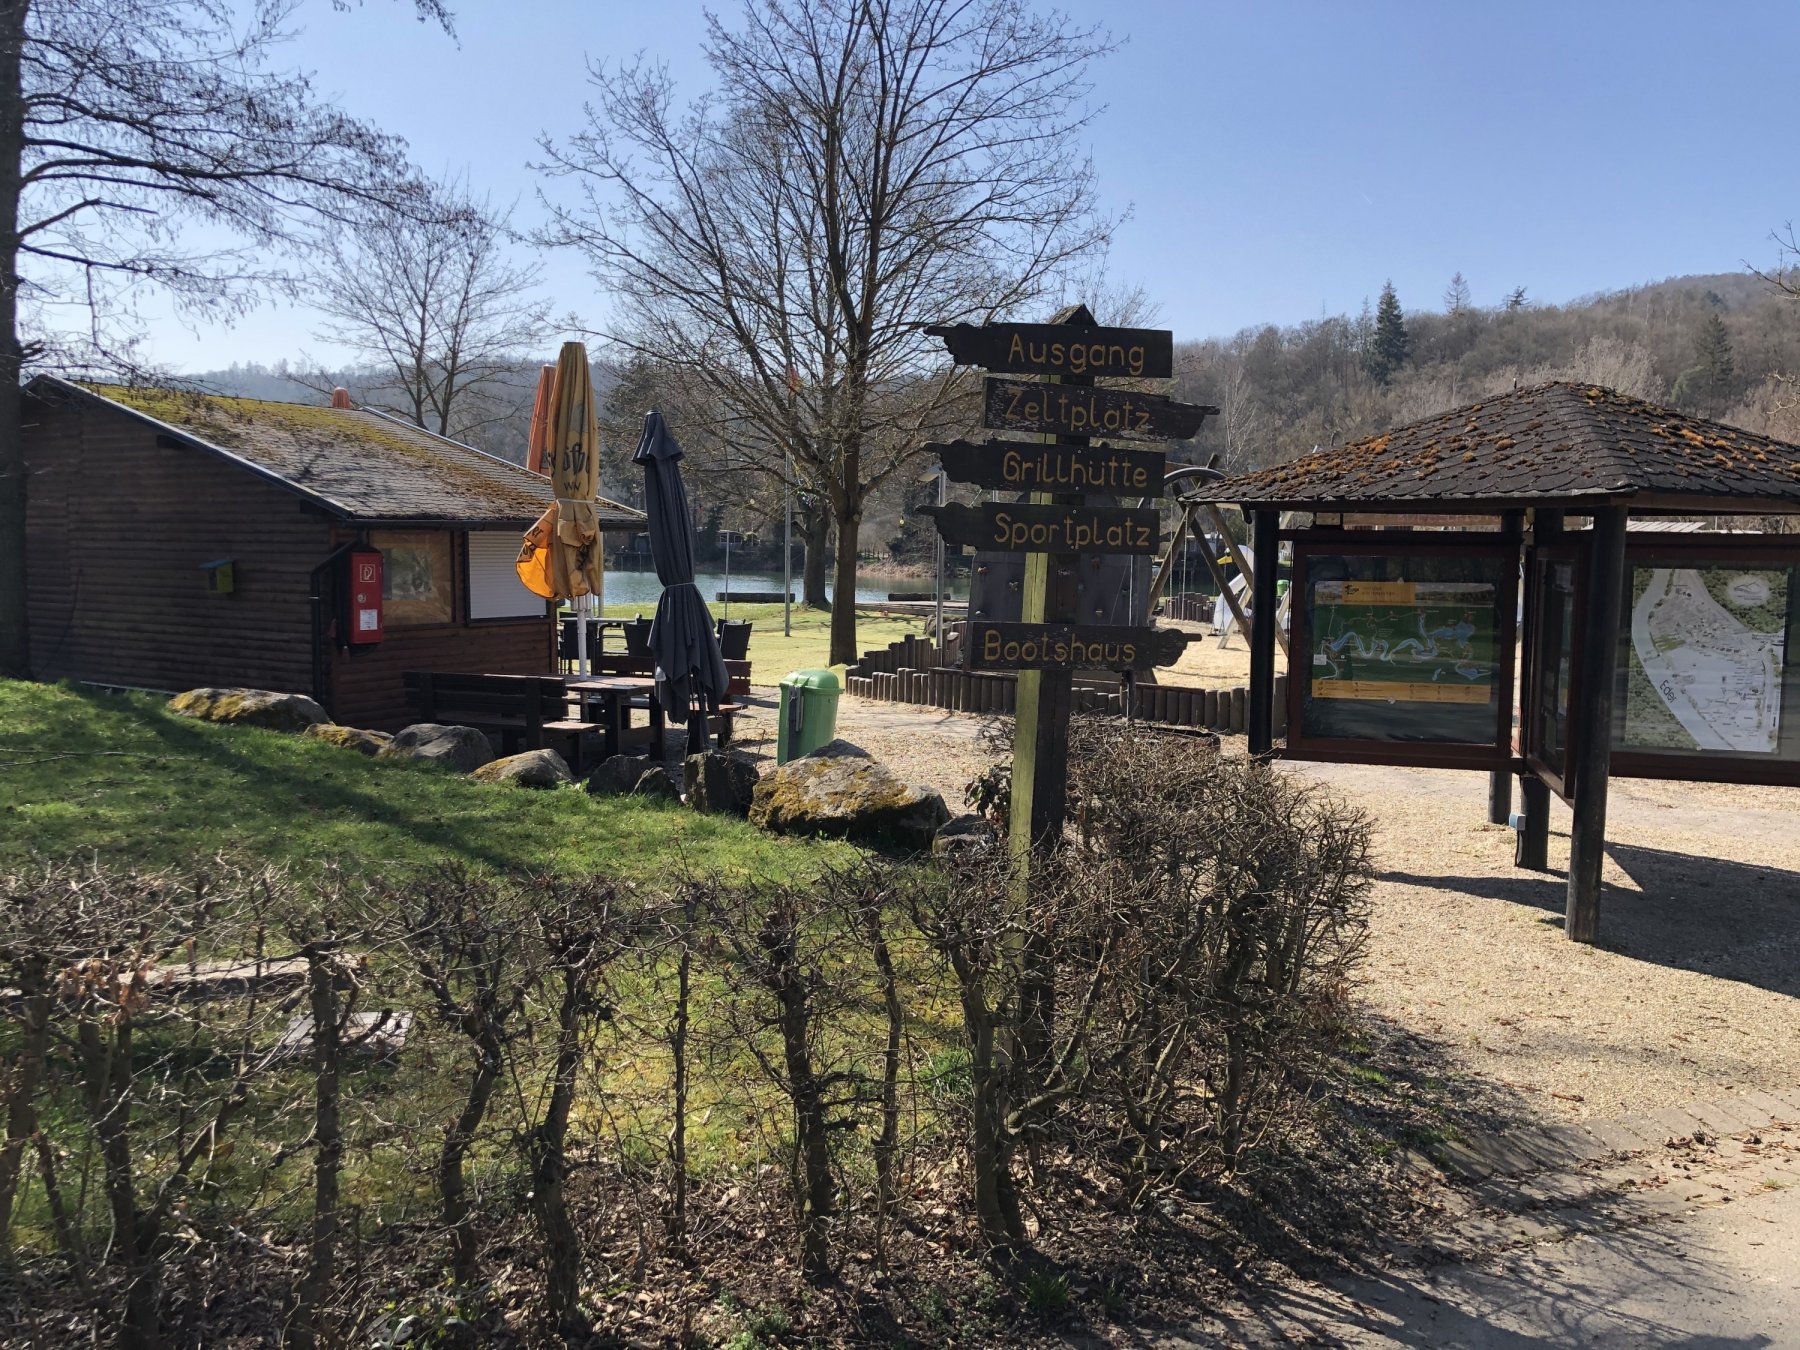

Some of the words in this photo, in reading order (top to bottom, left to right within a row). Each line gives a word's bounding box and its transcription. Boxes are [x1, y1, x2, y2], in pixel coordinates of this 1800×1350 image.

[1007, 332, 1145, 377] Ausgang
[1005, 386, 1151, 432] Zeltplatz
[1002, 450, 1148, 489] Grillhütte
[994, 512, 1151, 547] Sportplatz
[984, 629, 1137, 664] Bootshaus
